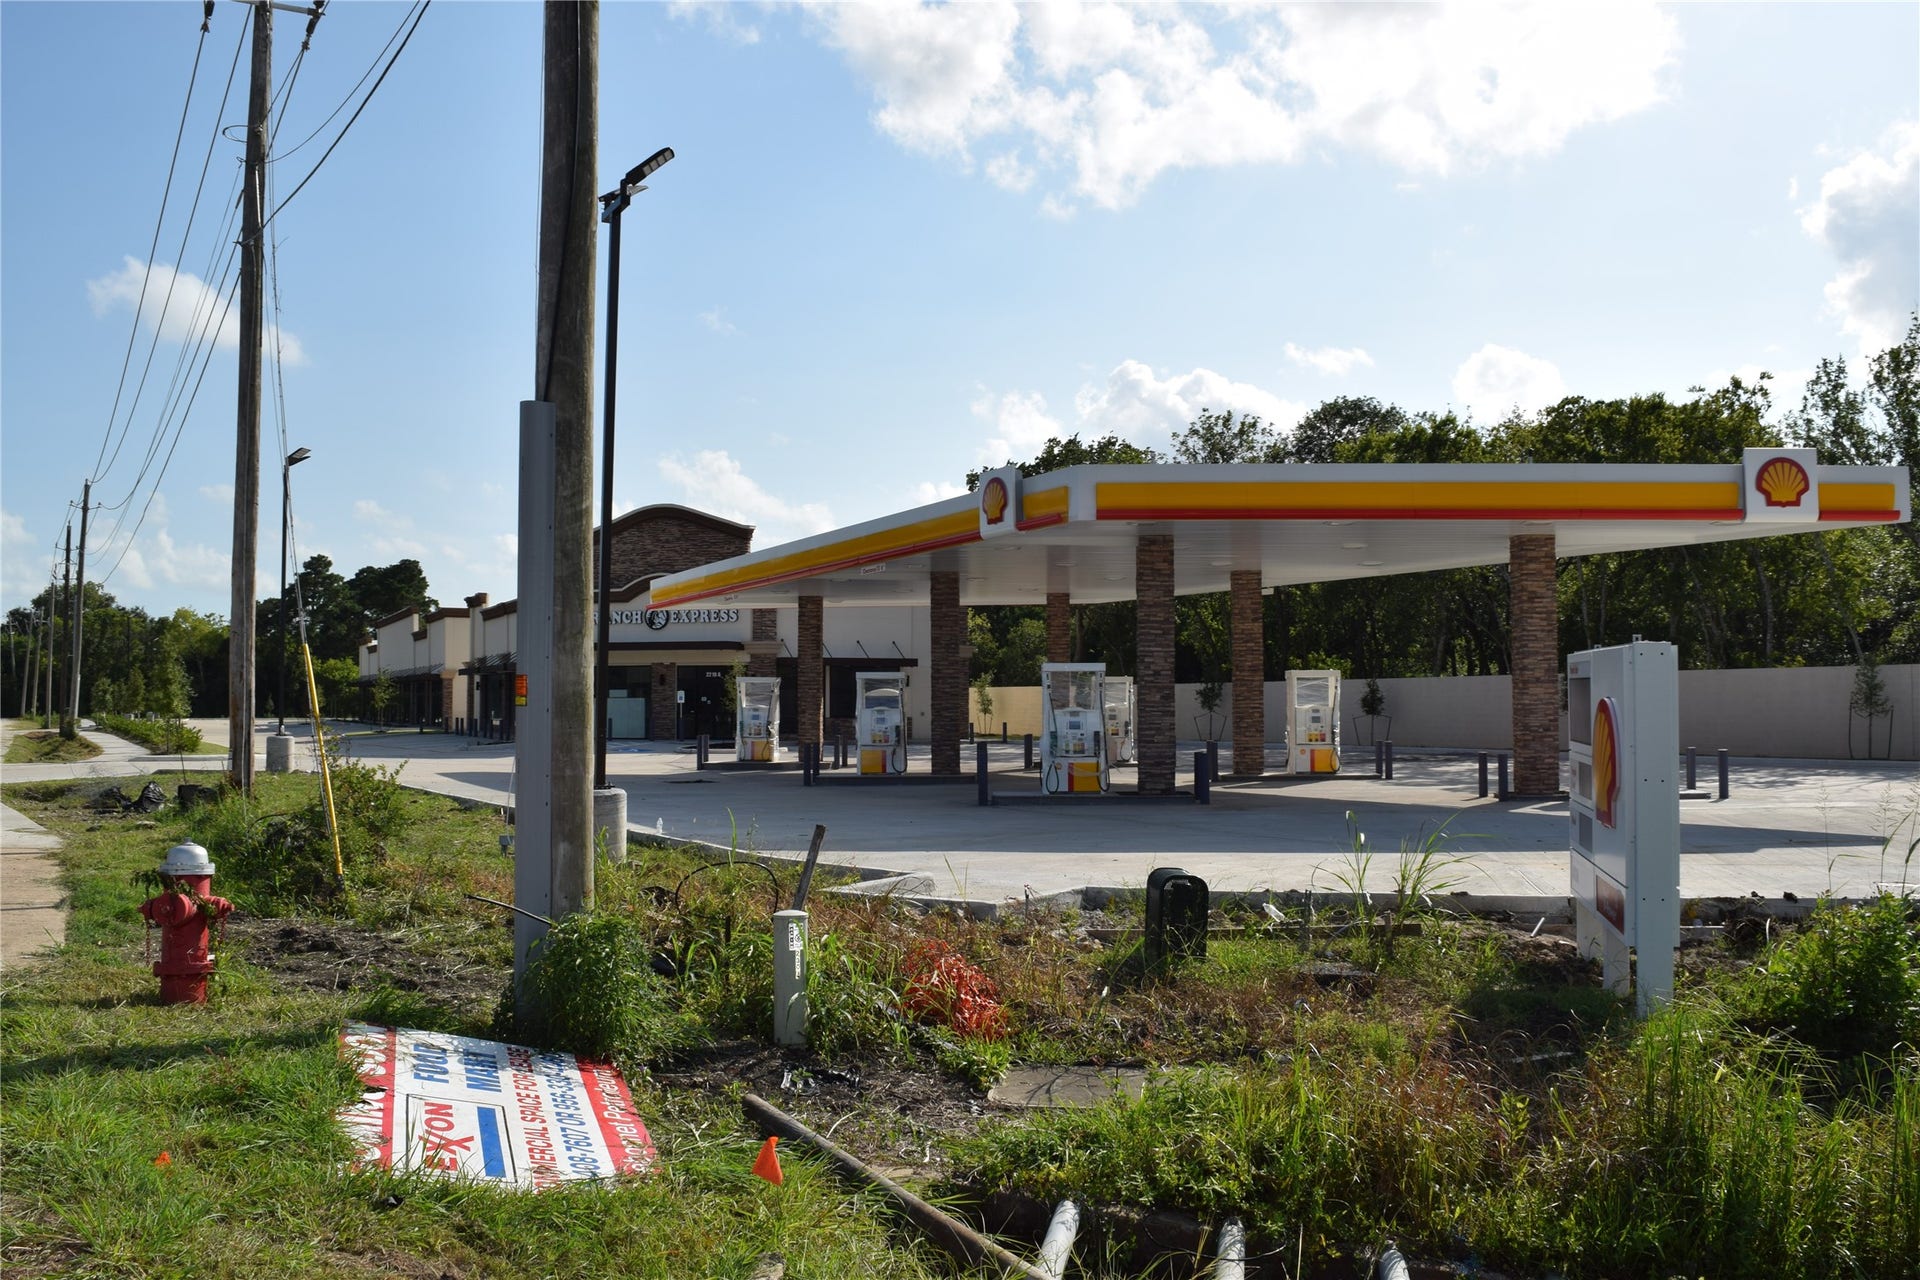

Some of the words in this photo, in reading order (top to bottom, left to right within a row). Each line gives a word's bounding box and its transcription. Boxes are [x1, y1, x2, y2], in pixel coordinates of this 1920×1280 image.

[671, 608, 739, 623] EXPRESS
[413, 1043, 449, 1084] FOOD
[462, 1048, 502, 1092] MART
[507, 1047, 534, 1073] LEASE
[512, 1072, 538, 1093] FOR
[592, 1069, 631, 1121] Petroleum
[517, 1092, 547, 1124] SPACE
[555, 1111, 586, 1126] OR
[417, 1102, 475, 1171] EXXON
